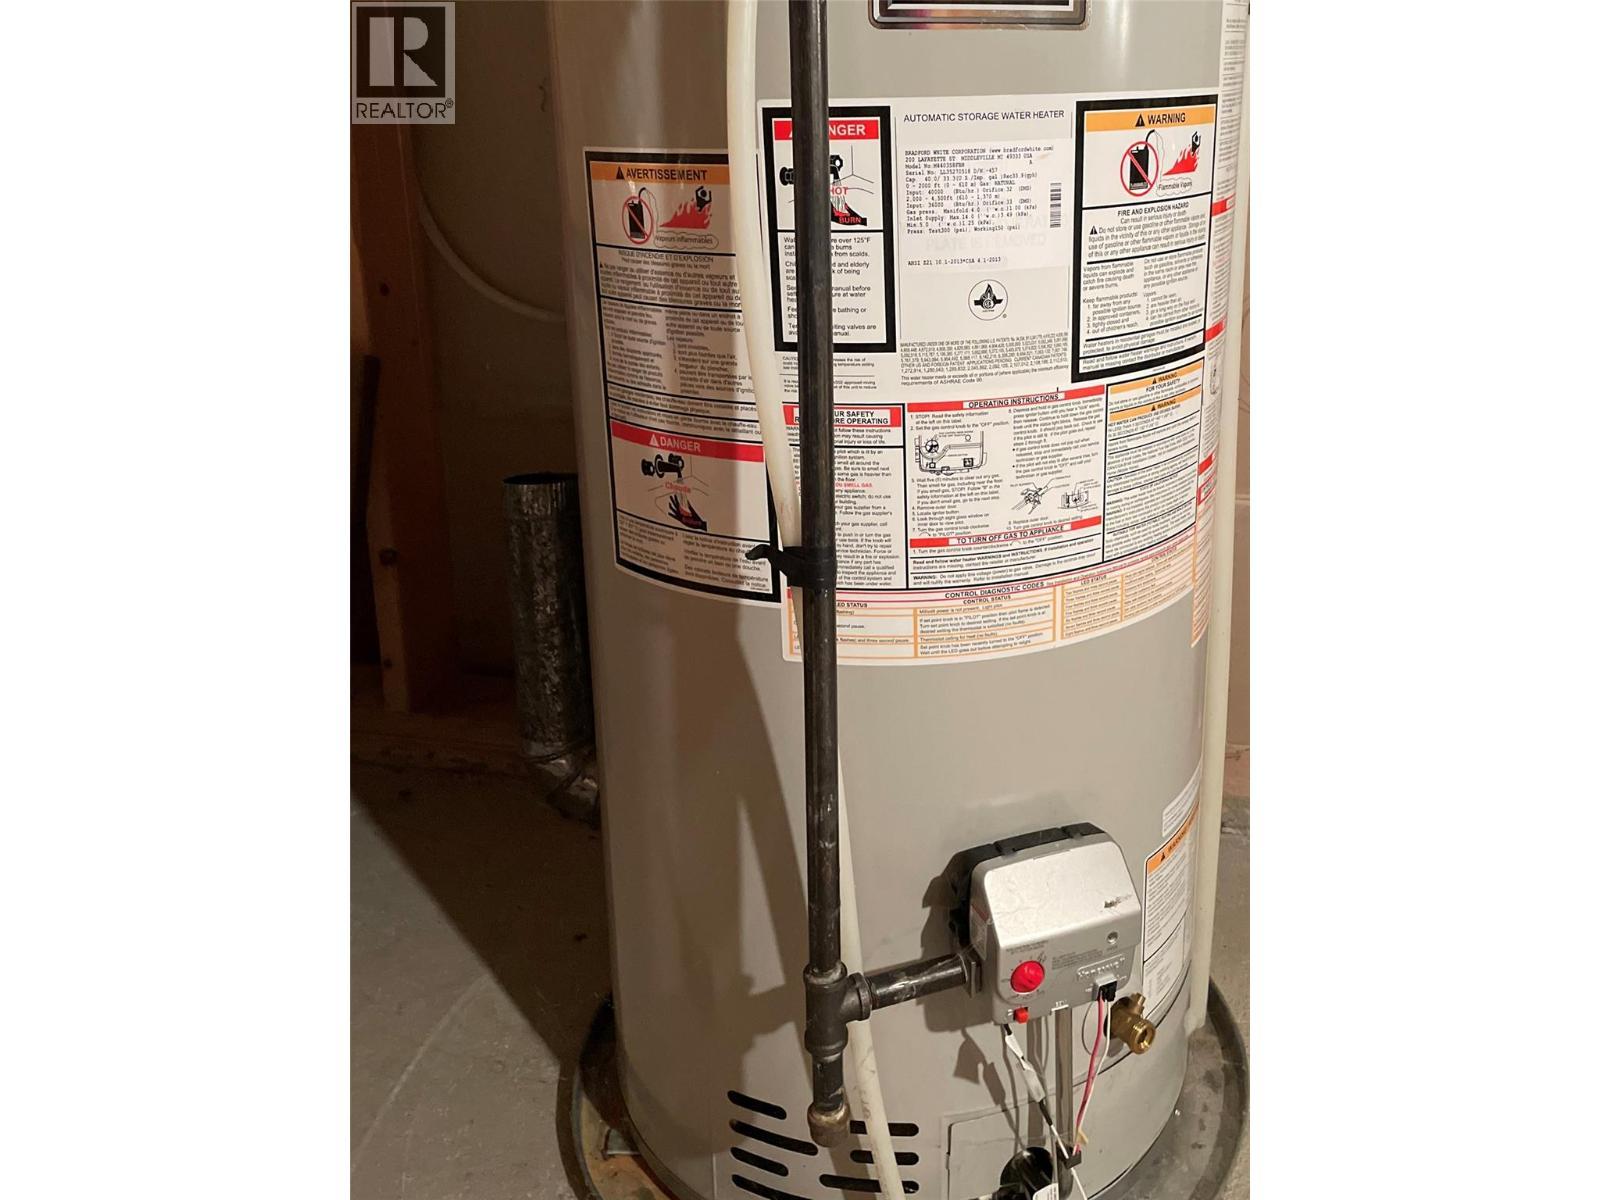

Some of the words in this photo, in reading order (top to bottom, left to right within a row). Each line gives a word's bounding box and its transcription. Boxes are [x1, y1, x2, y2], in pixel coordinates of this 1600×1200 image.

[904, 113, 955, 122] AUTOMATIC
[958, 112, 999, 121] STORAGE
[1001, 110, 1031, 120] WATER
[1033, 110, 1065, 118] HEATER
[1148, 112, 1186, 124] WARNING
[829, 125, 866, 136] NGER
[627, 168, 708, 181] AVERTISSEMENT
[1118, 209, 1131, 217] FIRE
[1144, 204, 1172, 214] EXPLOSION
[1171, 201, 1190, 210] HAZARD
[839, 216, 862, 224] BURN
[850, 260, 870, 269] elderly
[1083, 265, 1101, 273] Vapors
[844, 268, 861, 276] being
[838, 306, 860, 314] bathing
[969, 399, 1010, 409] OPERATING
[1010, 394, 1059, 406] INSTRUCTIONS
[846, 410, 875, 418] SAFETY
[660, 437, 701, 452] DANGER
[968, 535, 988, 544] TURN
[988, 533, 1003, 542] OFF
[1003, 531, 1018, 540] GAS
[1019, 529, 1029, 538] TO
[1029, 525, 1065, 536] APPLIANCE
[945, 590, 978, 599] CONTROL
[979, 585, 1021, 596] DIAGNOSTIC
[1022, 581, 1045, 590] CODES
[962, 597, 990, 605] CONTROL
[990, 594, 1012, 602] STATUS
